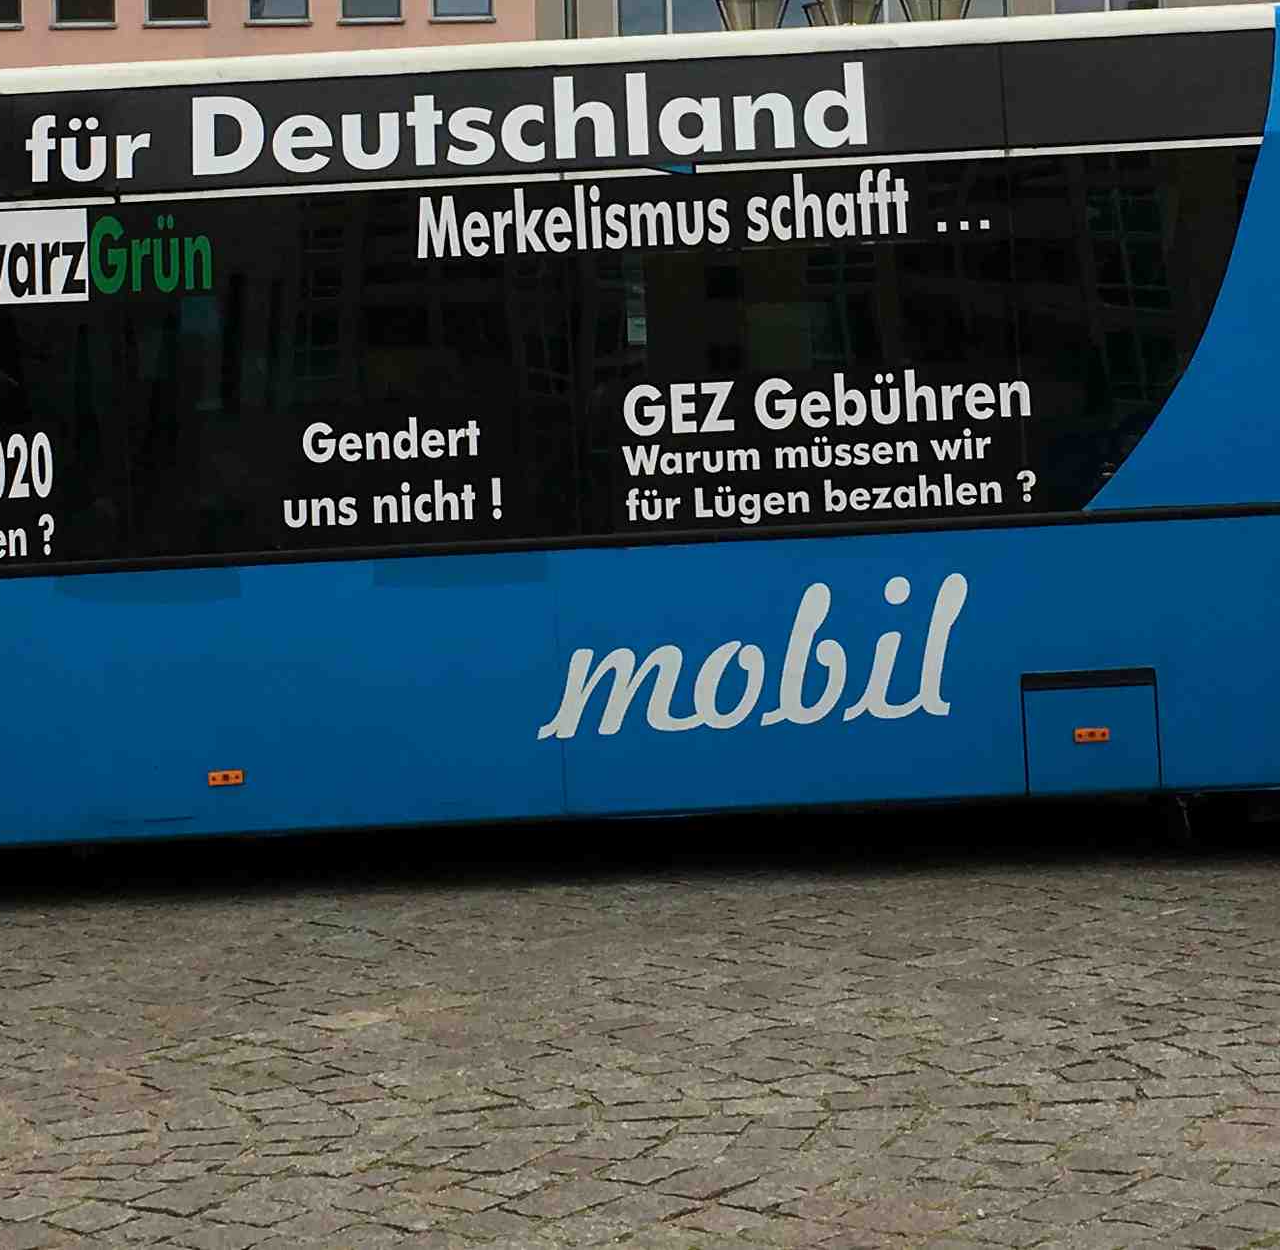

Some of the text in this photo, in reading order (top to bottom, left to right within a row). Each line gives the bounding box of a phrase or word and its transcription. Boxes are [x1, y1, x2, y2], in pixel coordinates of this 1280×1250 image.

[25, 114, 151, 183] für
[191, 61, 868, 176] Deutschland
[417, 183, 731, 259] Merkelismus
[747, 168, 909, 242] schafft
[623, 368, 1032, 437] GEZ Gebühren
[302, 416, 481, 463] Gendert
[621, 427, 992, 476] Warum müssen wir
[283, 476, 503, 528] uns nicht !
[625, 468, 1038, 524] für Lügen bezahlen ?
[37, 512, 56, 557] ?
[538, 573, 968, 740] mobil
